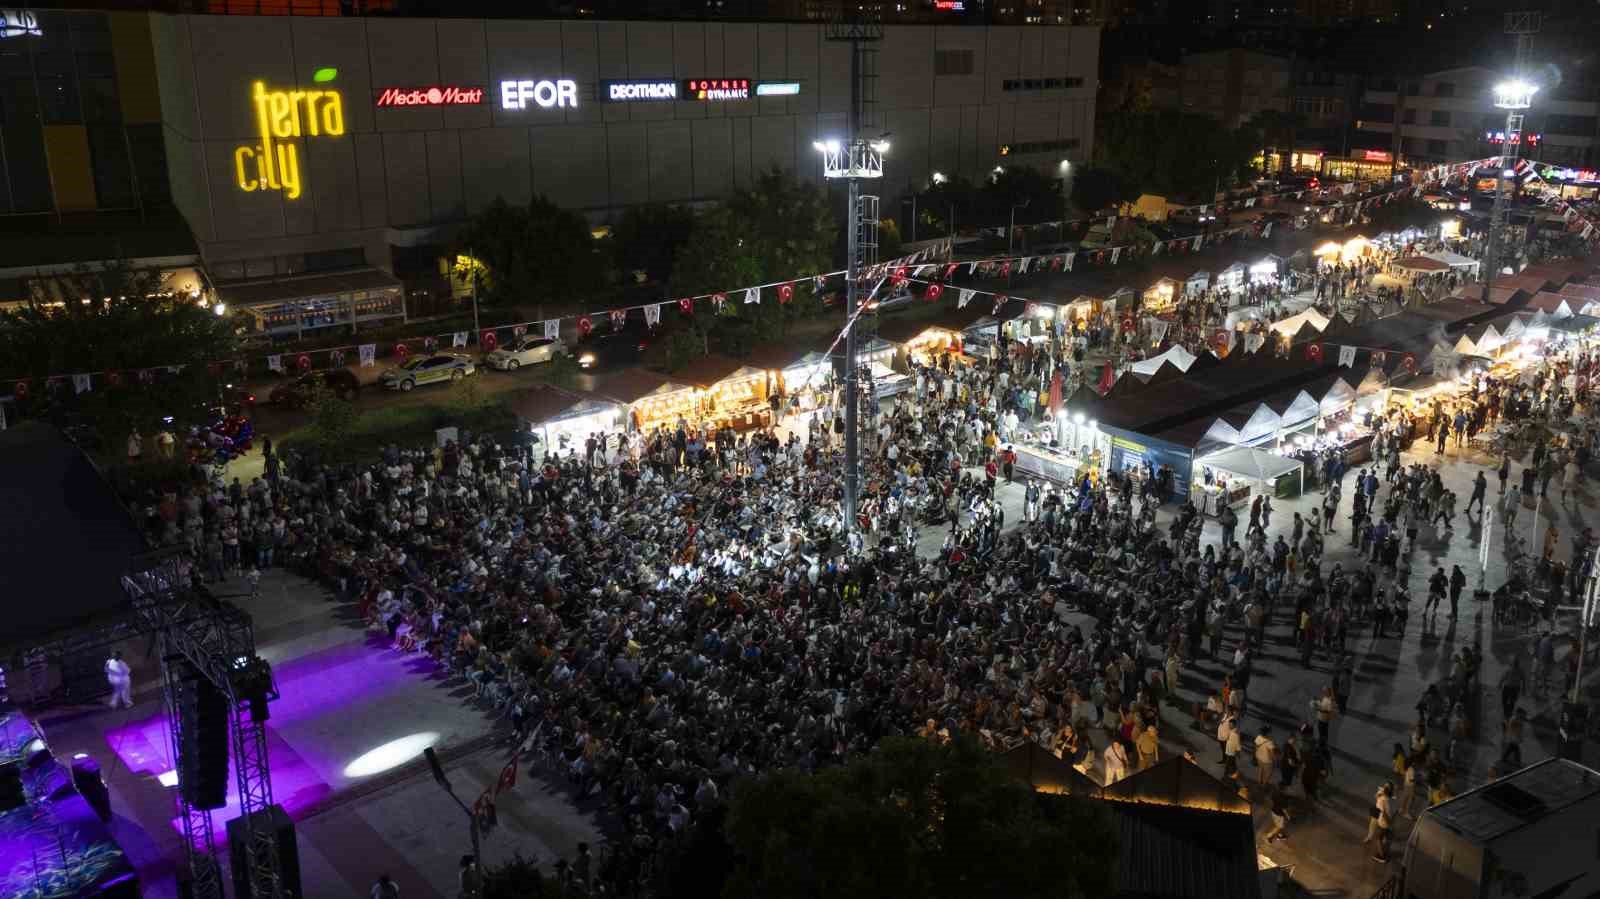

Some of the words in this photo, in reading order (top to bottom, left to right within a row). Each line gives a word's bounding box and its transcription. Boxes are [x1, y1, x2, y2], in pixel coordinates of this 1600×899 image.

[501, 80, 577, 109] EFOR
[610, 83, 675, 99] DECATHLON
[690, 81, 748, 90] BOYNER
[707, 89, 748, 100] DYNAMIC
[253, 82, 345, 138] terra
[235, 143, 302, 199] city
